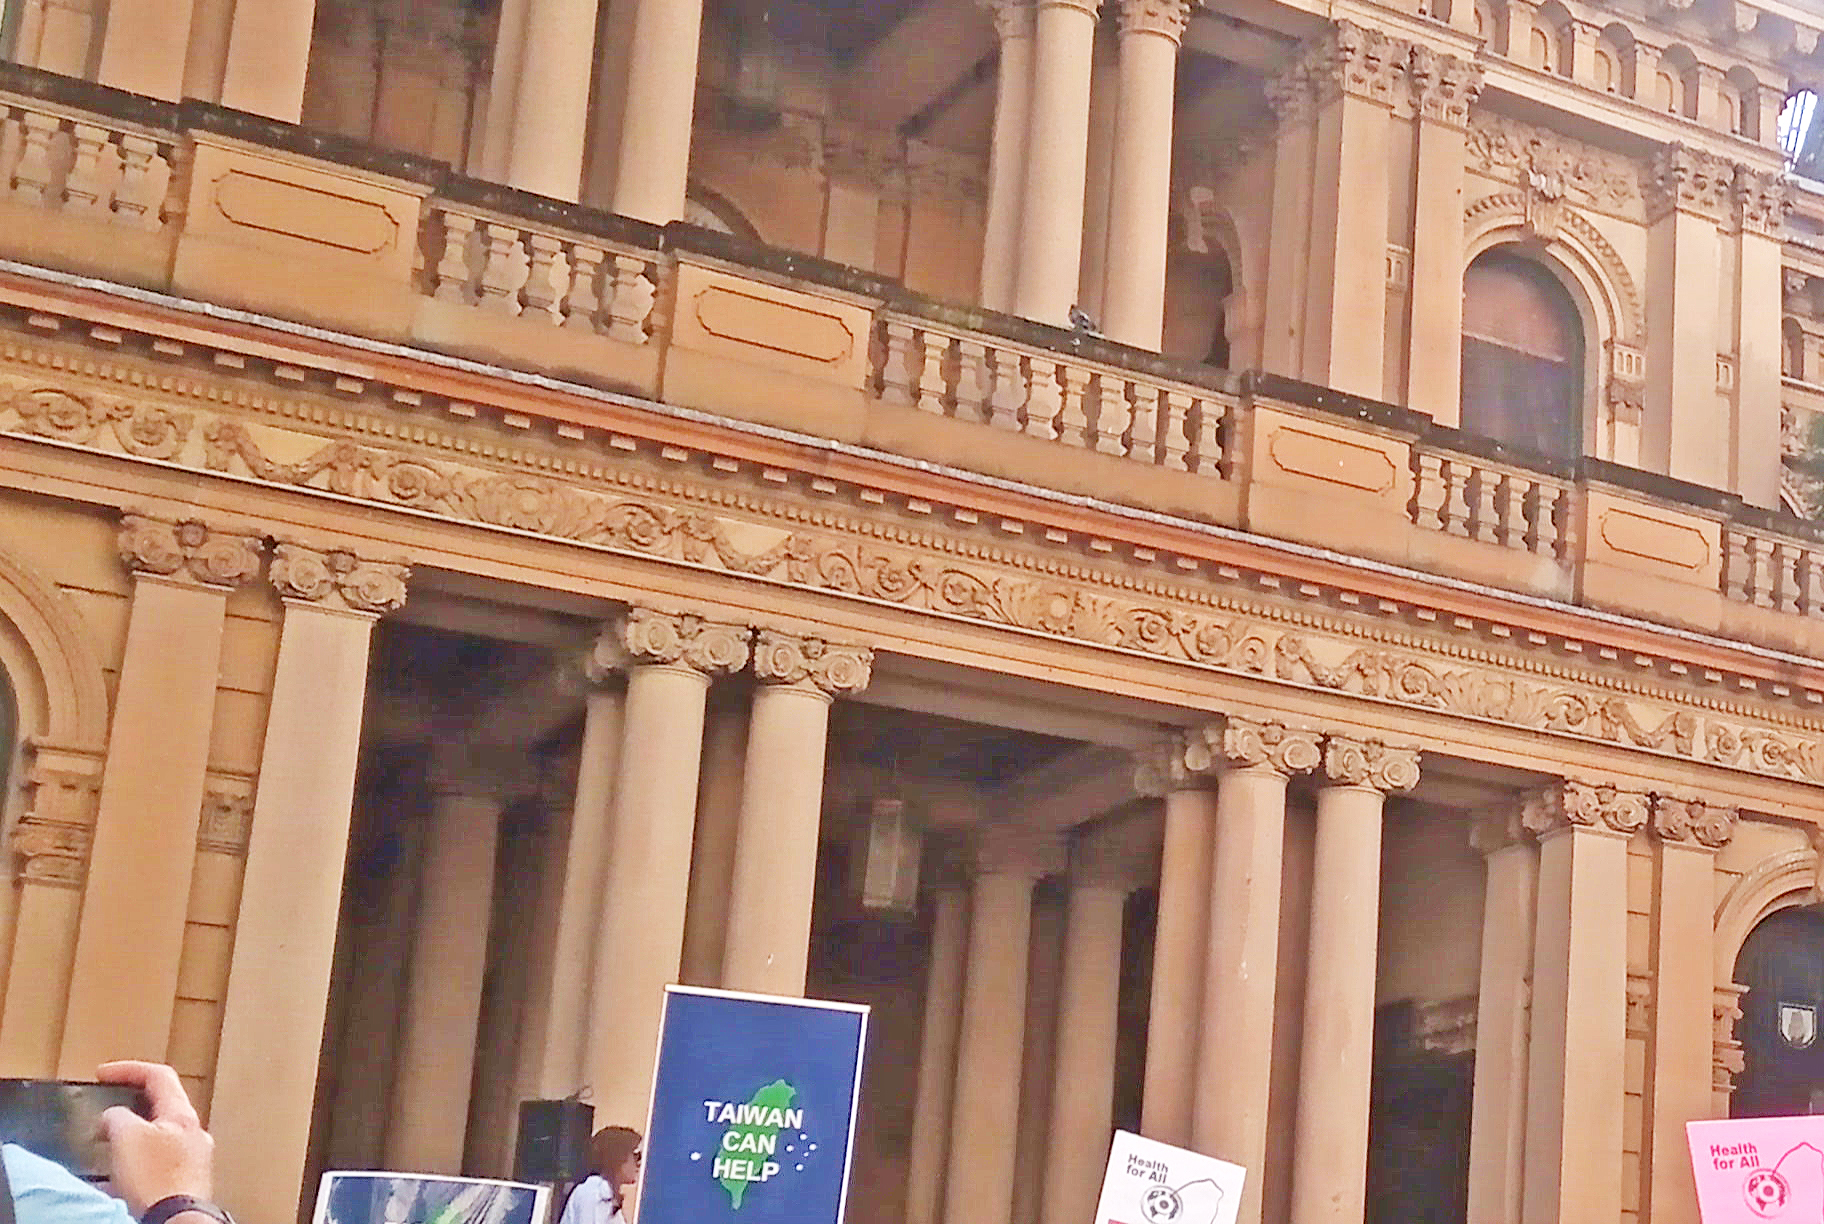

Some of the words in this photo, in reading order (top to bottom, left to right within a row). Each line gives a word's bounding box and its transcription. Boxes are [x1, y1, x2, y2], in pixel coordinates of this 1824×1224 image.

[704, 1100, 804, 1129] TAIWAN
[722, 1131, 777, 1155] CAN
[1710, 1142, 1758, 1158] Health
[713, 1157, 780, 1182] HELP
[1127, 1153, 1169, 1174] Health
[1713, 1158, 1735, 1171] for
[1740, 1155, 1760, 1168] All
[1126, 1164, 1146, 1179] for
[1148, 1170, 1168, 1184] All
